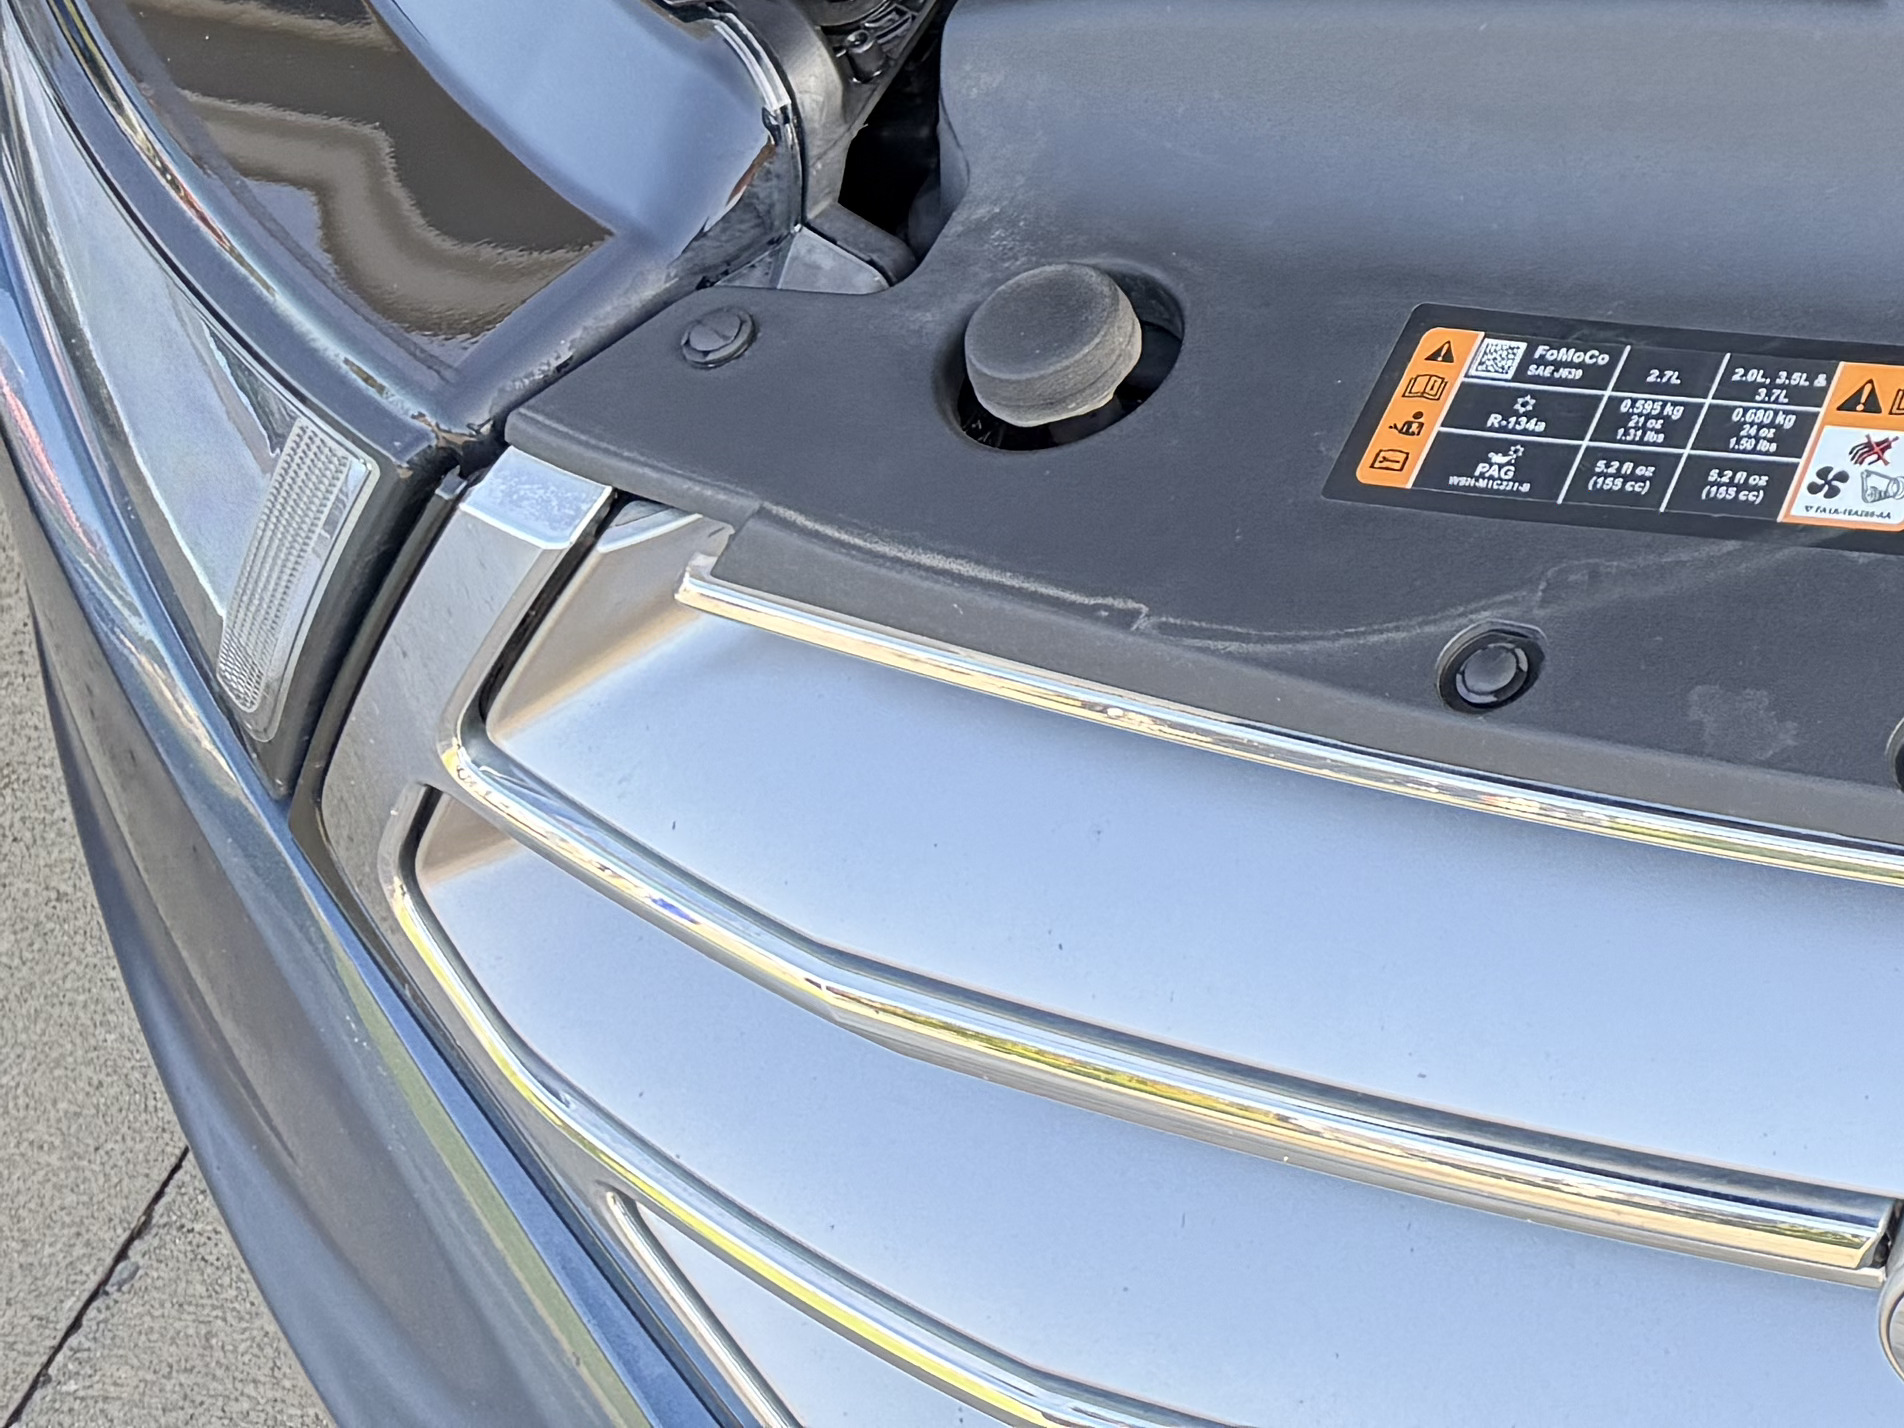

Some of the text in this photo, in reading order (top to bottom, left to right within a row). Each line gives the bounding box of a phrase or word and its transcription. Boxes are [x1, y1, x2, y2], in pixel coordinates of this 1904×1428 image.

[1534, 345, 1610, 365] FoMoCo
[1527, 364, 1554, 379] SAE
[1646, 369, 1681, 384] 2.7L
[1731, 368, 1828, 387] 2.0L, 3.5L &
[1755, 388, 1789, 403] 3.7L
[1620, 399, 1684, 420] 0.595 kg
[1487, 413, 1546, 432] R-134a
[1627, 415, 1663, 430] 21 oz
[1732, 407, 1796, 429] 0.680 kg
[1616, 428, 1665, 443] 1.31 lbs
[1740, 424, 1776, 438] 24 oz
[1729, 437, 1777, 452] 1.50 lbs
[1474, 463, 1516, 479] PAG
[1594, 460, 1655, 477] 5.2 fl oz
[1707, 469, 1769, 486] 5.2 fl oz
[1624, 479, 1650, 494] cc)
[1738, 489, 1764, 504] cc)
